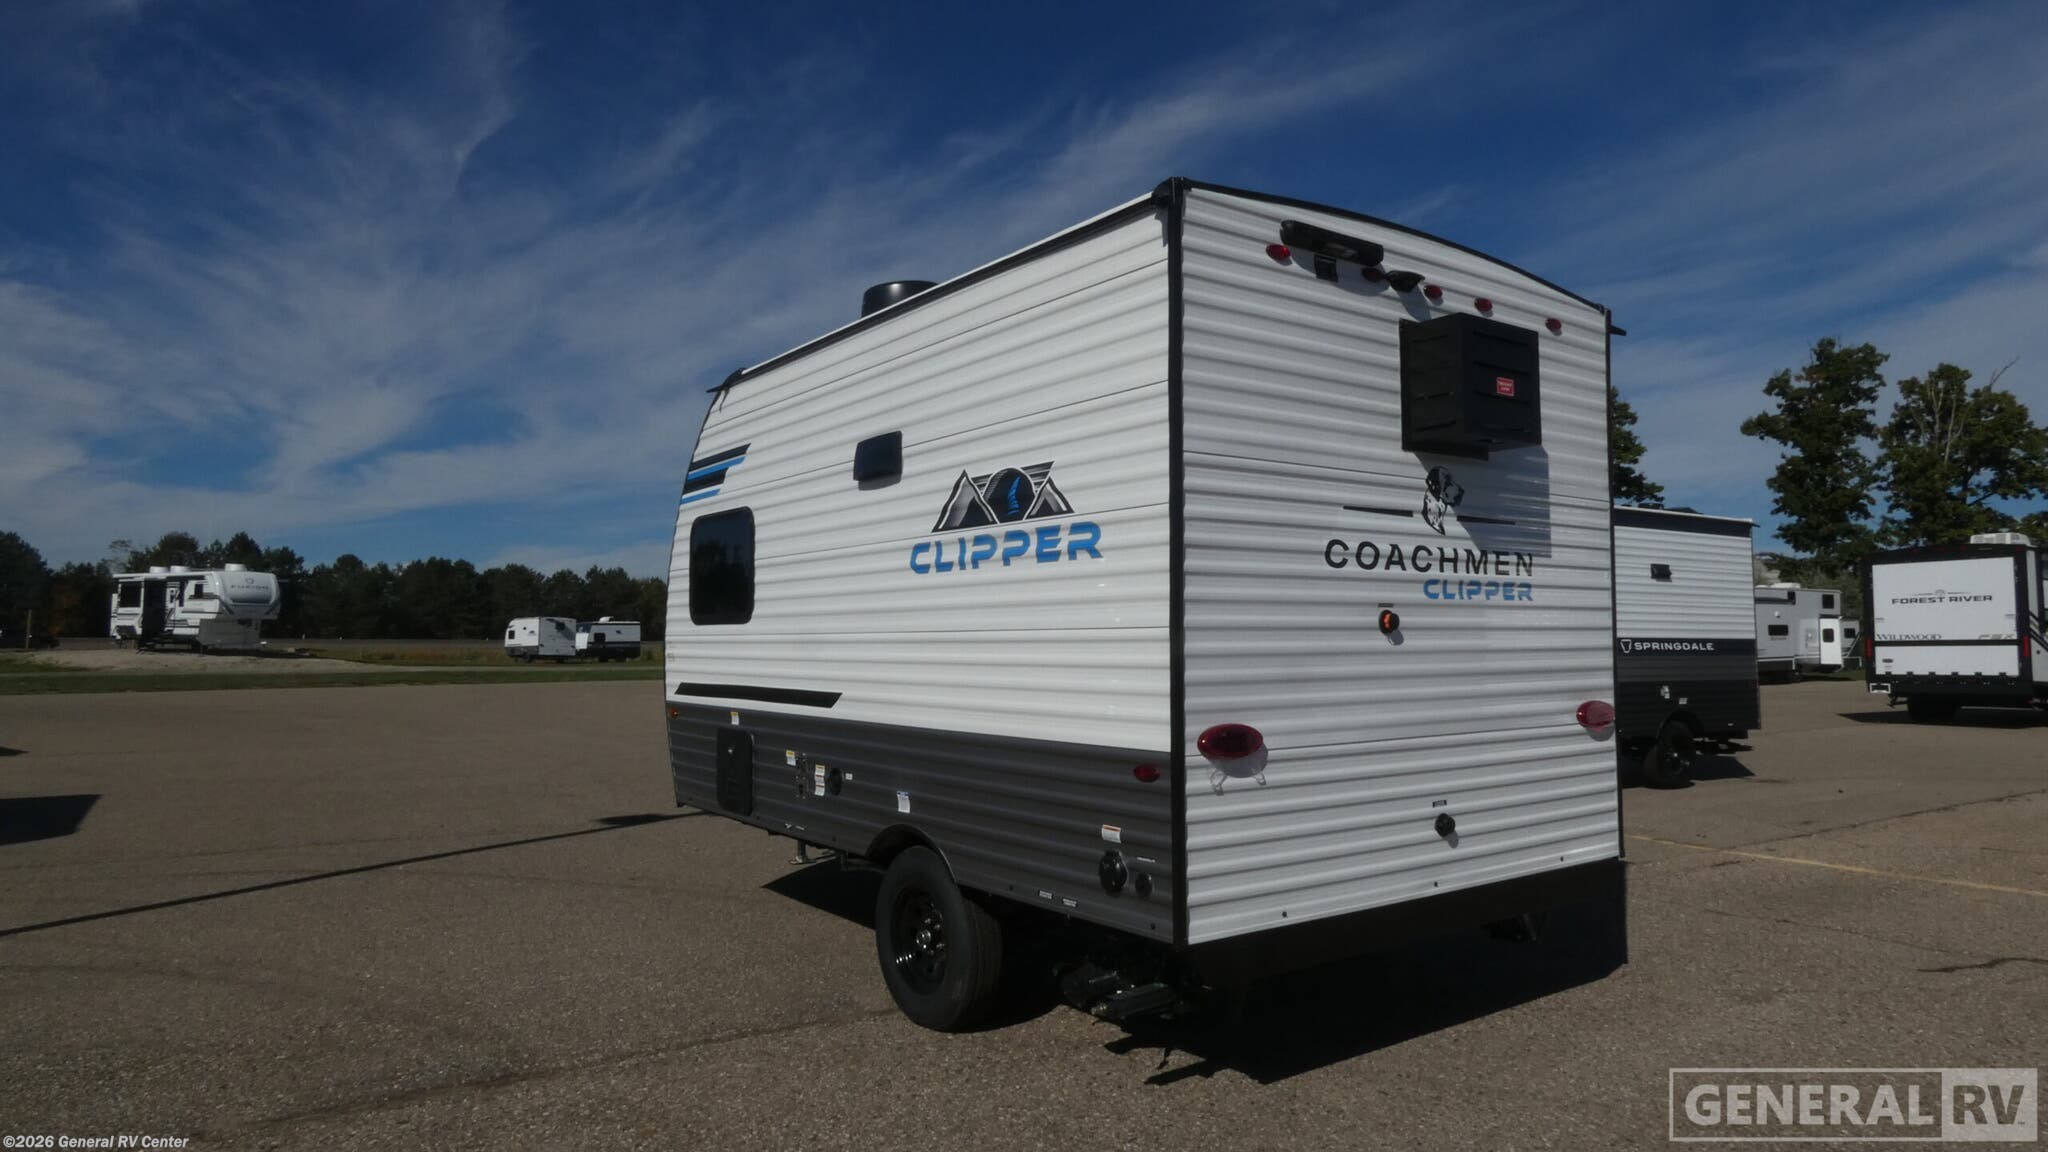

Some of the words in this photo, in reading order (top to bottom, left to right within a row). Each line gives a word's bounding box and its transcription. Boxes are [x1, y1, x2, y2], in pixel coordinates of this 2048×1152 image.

[910, 521, 1104, 574] CLIPPER
[1325, 539, 1533, 576] COACHMEN
[1423, 579, 1534, 601] CLIPPER
[1891, 596, 1945, 604] FOREST
[1633, 642, 1715, 651] SPRINGDALE
